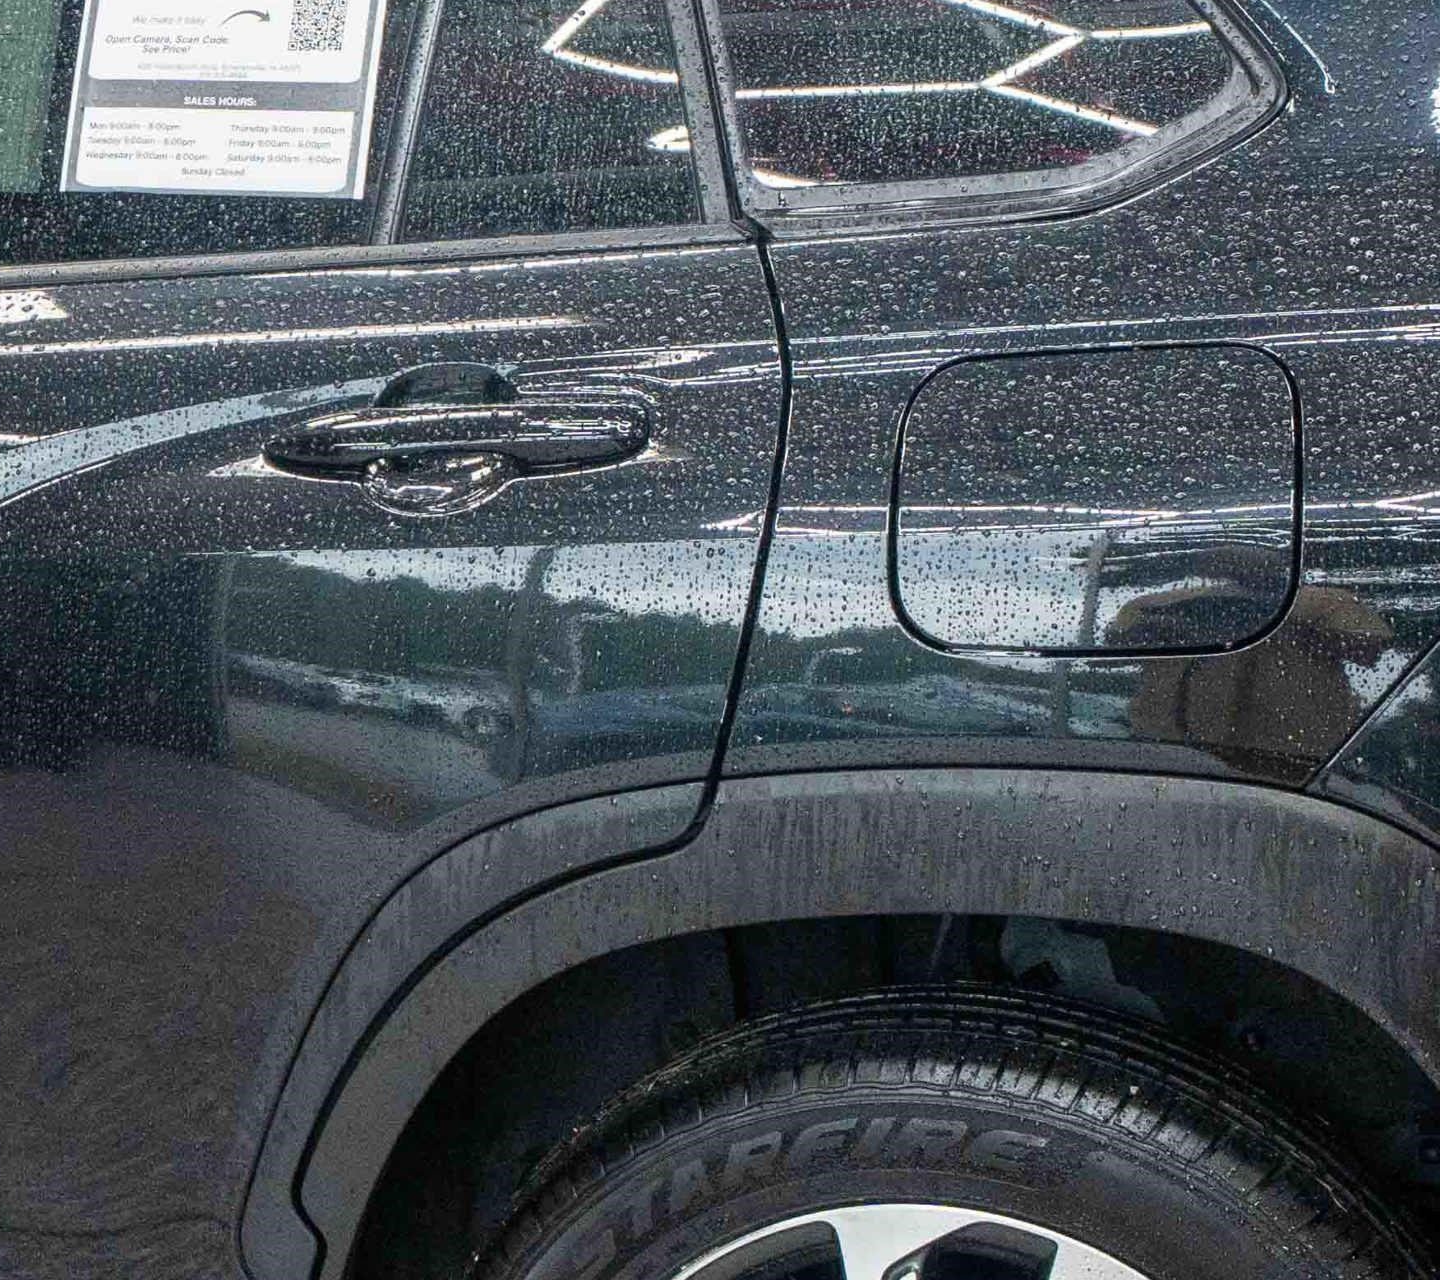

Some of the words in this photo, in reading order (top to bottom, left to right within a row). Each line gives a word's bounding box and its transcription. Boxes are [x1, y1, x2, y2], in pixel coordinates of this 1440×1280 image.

[105, 35, 131, 45] Open
[175, 35, 200, 44] Scan
[183, 96, 216, 106] SALES
[219, 97, 257, 107] HOURS:
[229, 140, 255, 148] Friday
